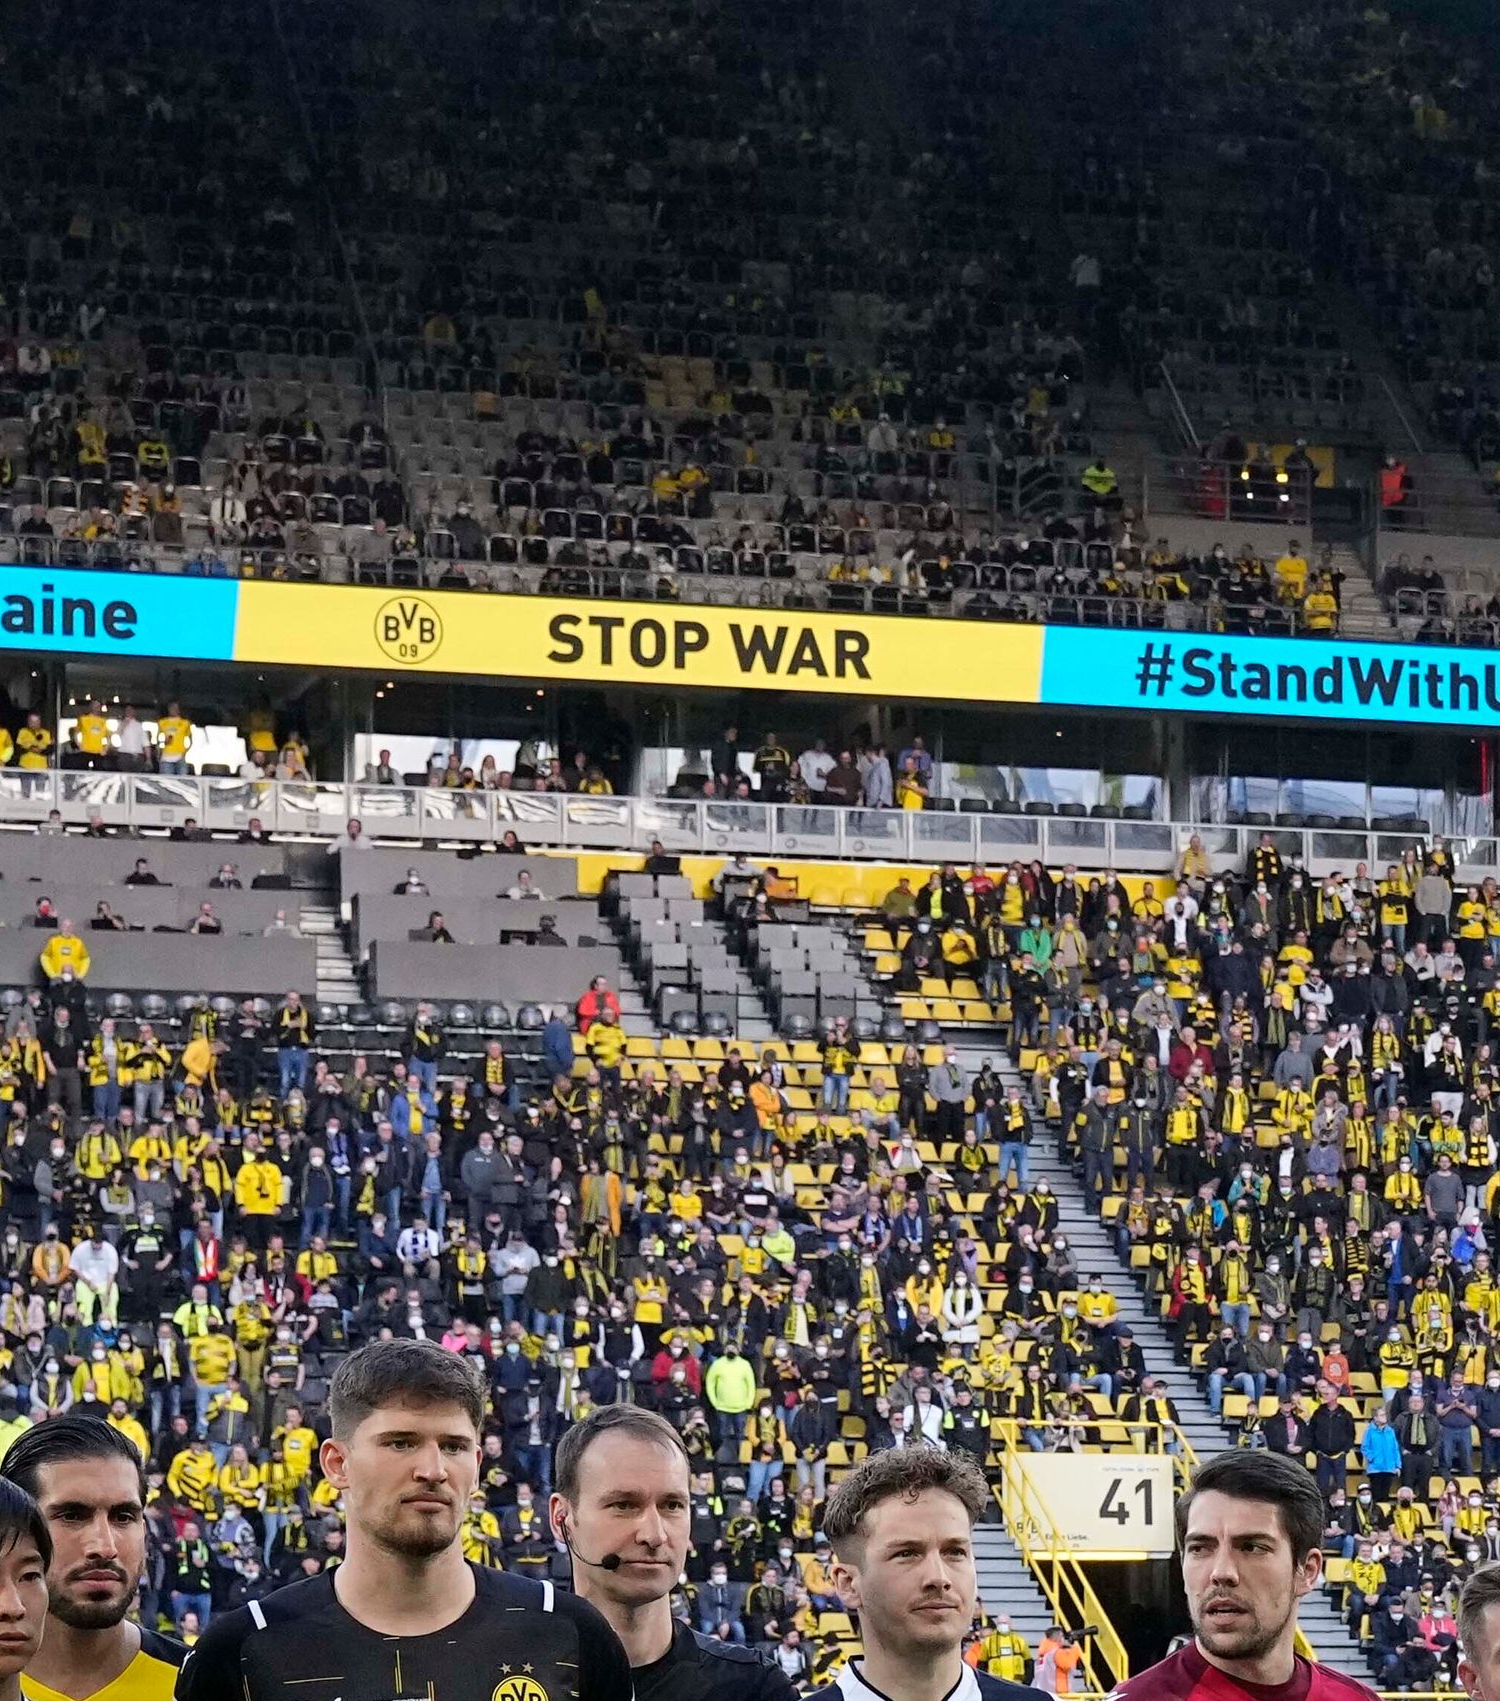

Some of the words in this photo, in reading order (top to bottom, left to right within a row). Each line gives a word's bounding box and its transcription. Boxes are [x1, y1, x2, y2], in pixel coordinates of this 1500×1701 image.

[383, 601, 437, 644] BVB
[399, 644, 419, 658] 09
[547, 614, 710, 670] STOP
[729, 624, 873, 680] WAR
[1099, 1478, 1153, 1525] 41
